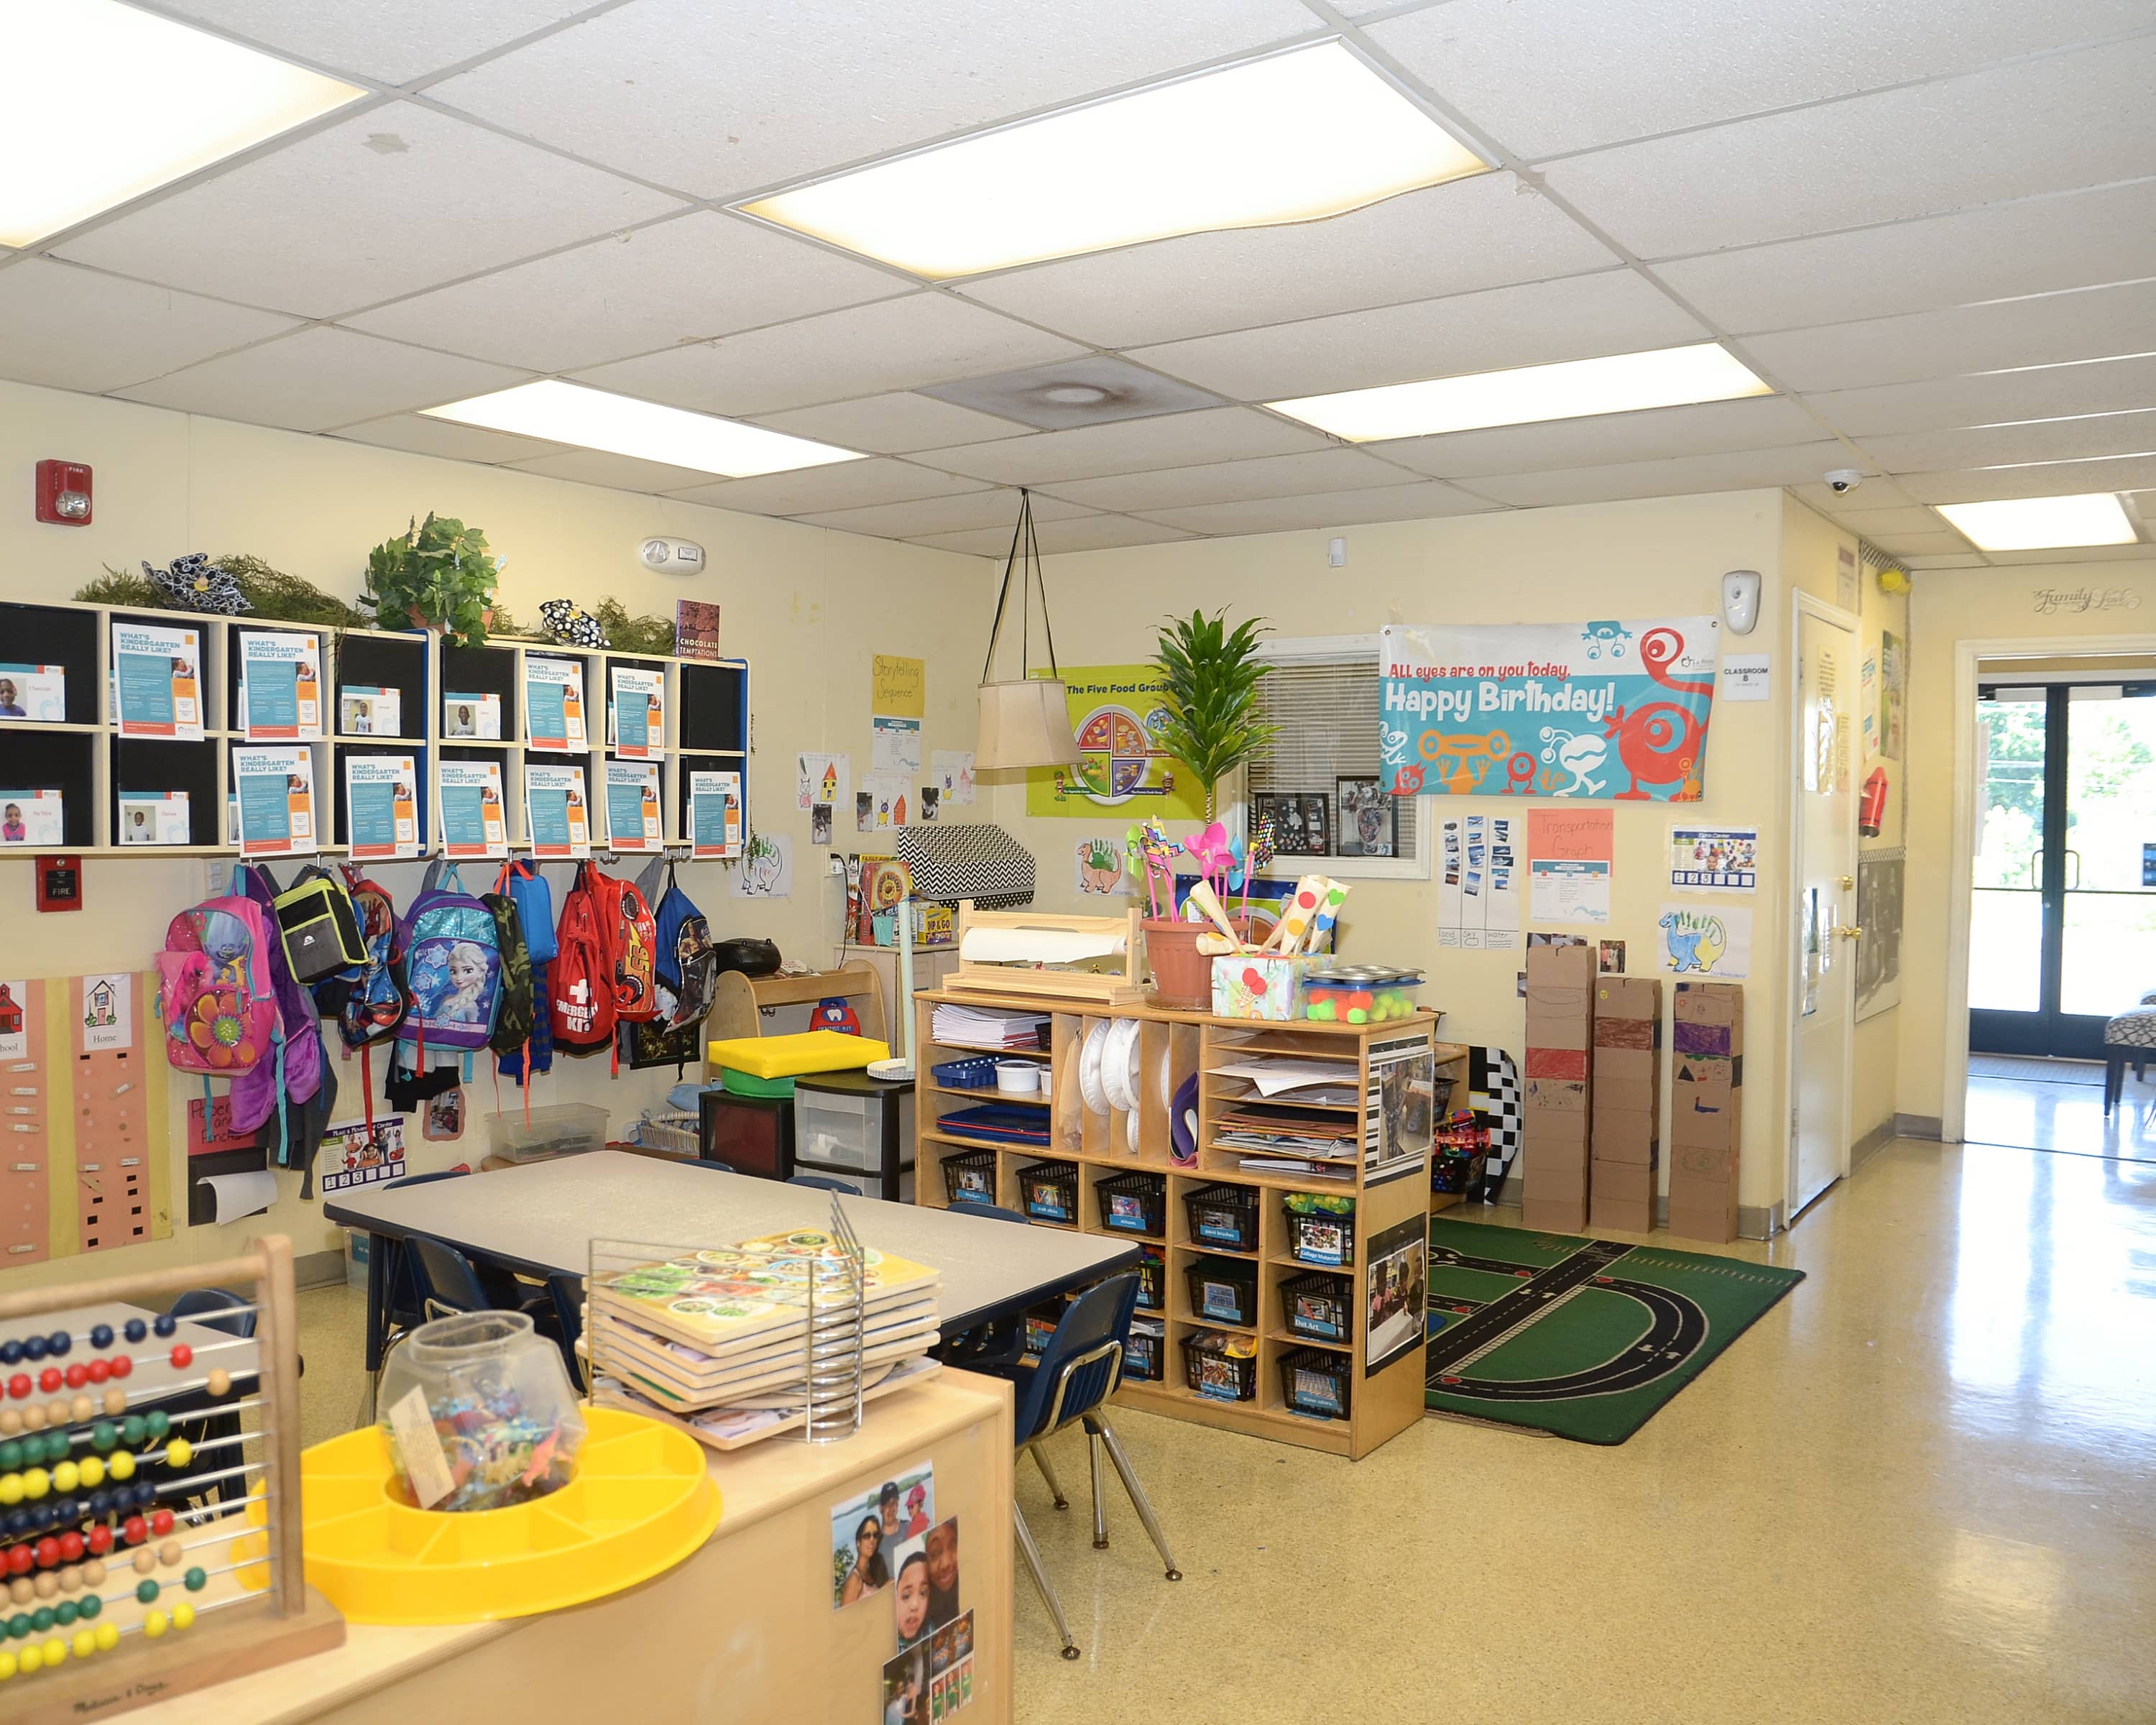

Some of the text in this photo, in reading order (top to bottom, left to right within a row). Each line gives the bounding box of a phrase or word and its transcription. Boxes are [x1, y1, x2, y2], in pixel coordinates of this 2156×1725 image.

[120, 632, 150, 640] WHAT'S
[120, 638, 180, 649] KINDERGARTEN
[680, 637, 718, 649] CHOCOLATE
[679, 647, 718, 658] TEMPTATIONS
[872, 655, 919, 688] Storytelling
[1416, 664, 1447, 683] eyes
[1450, 664, 1474, 677] are
[1478, 664, 1495, 677] on
[1497, 664, 1524, 682] you
[1527, 661, 1571, 682] today.
[877, 678, 913, 704] Sequence
[1067, 683, 1169, 694] The Five Food Group
[1385, 680, 1616, 723] Happy Birthday!
[1532, 814, 1613, 835] Transportation
[1552, 835, 1593, 859] Graph
[1676, 873, 1709, 883] 1 2 3
[927, 920, 950, 931] DIP & GO
[93, 1035, 117, 1043] Home
[0, 1044, 18, 1052] hool
[327, 1172, 361, 1187] 1 2 3
[1300, 1250, 1341, 1261] Collage Materials
[1209, 1307, 1228, 1316] Stencils
[1295, 1319, 1320, 1330] Dot Art
